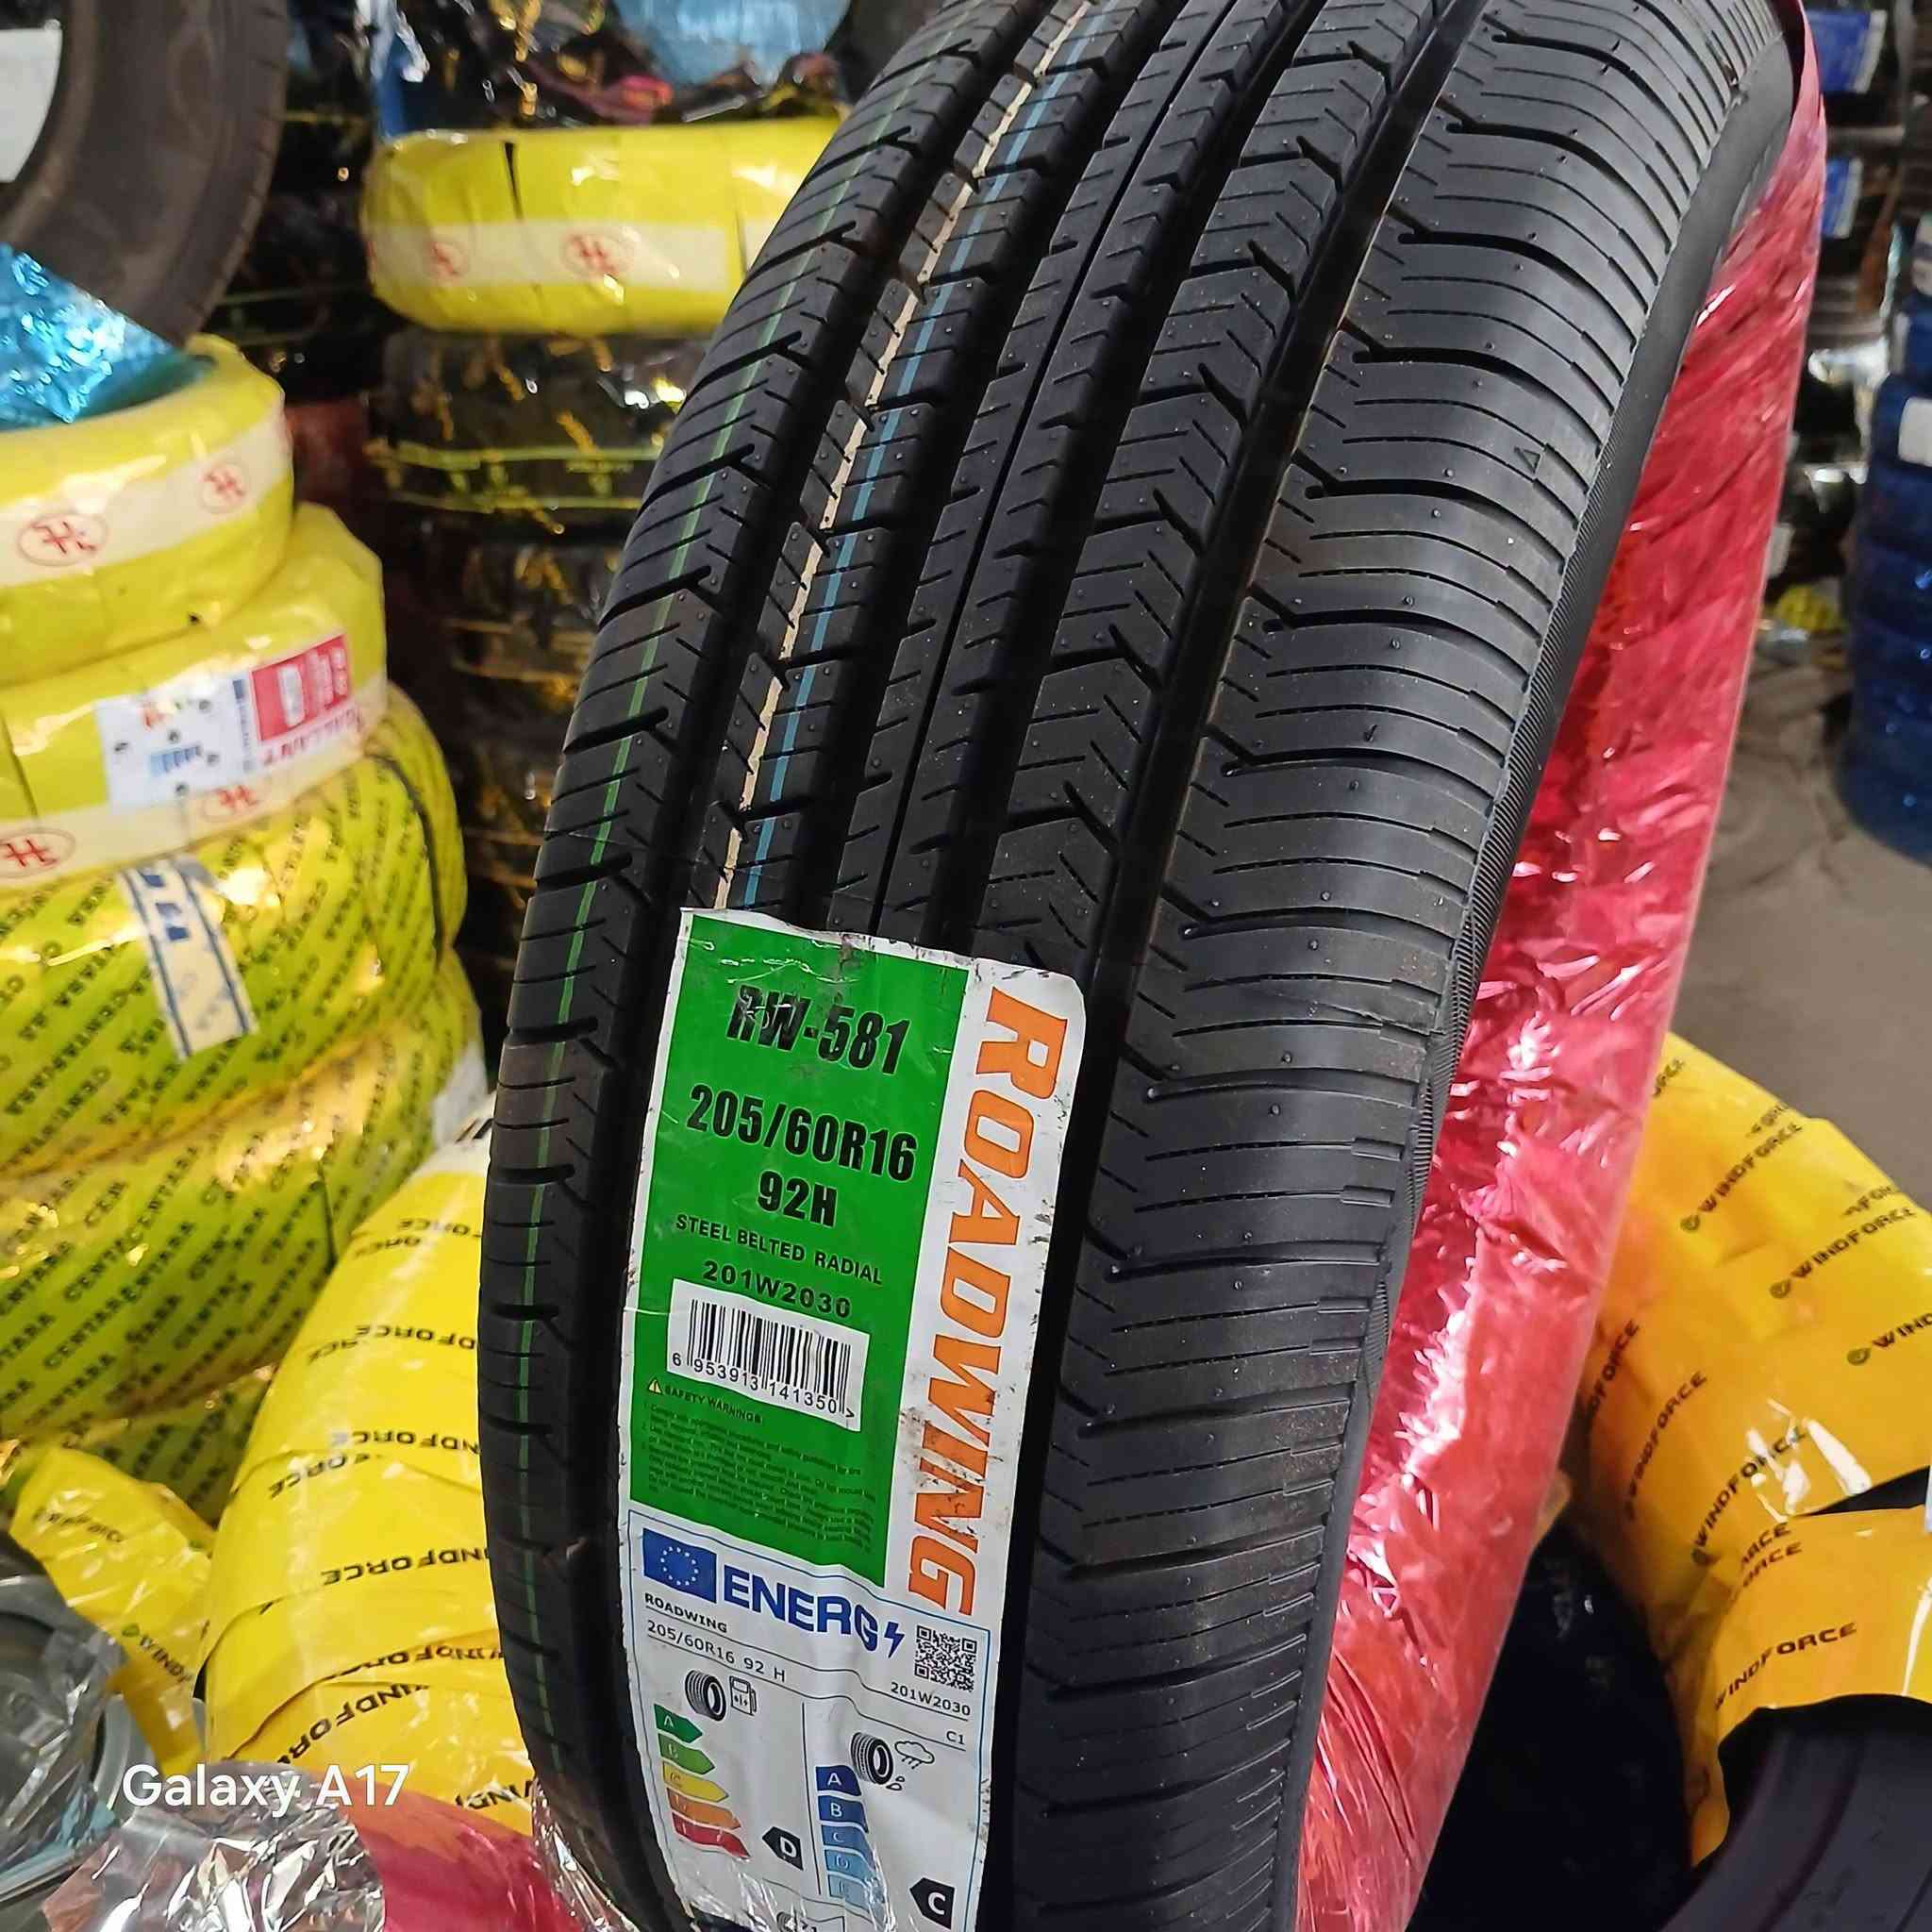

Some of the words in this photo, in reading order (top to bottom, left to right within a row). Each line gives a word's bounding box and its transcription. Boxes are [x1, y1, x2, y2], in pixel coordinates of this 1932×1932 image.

[725, 983, 911, 1075] RW-581
[686, 1083, 918, 1183] 205/60R16
[756, 1170, 839, 1228] 92H
[675, 1213, 732, 1243] STEEL
[737, 1229, 806, 1262] BELTED
[814, 1251, 883, 1285] RADIAL
[702, 1259, 851, 1318] 201W2030
[908, 986, 1070, 1617] ROADWING
[693, 1357, 759, 1391] 953913
[769, 1382, 838, 1414] 141350
[644, 1591, 728, 1634] ROADWING
[647, 1619, 736, 1664] 205/60R16
[743, 1657, 765, 1674] 92
[774, 1667, 786, 1683] H
[890, 1681, 972, 1717] 201W2030
[945, 1730, 967, 1745] C1
[826, 1772, 842, 1787] A
[829, 1803, 843, 1818] B
[779, 1836, 797, 1858] D
[832, 1831, 845, 1844] C
[927, 1891, 946, 1915] C
